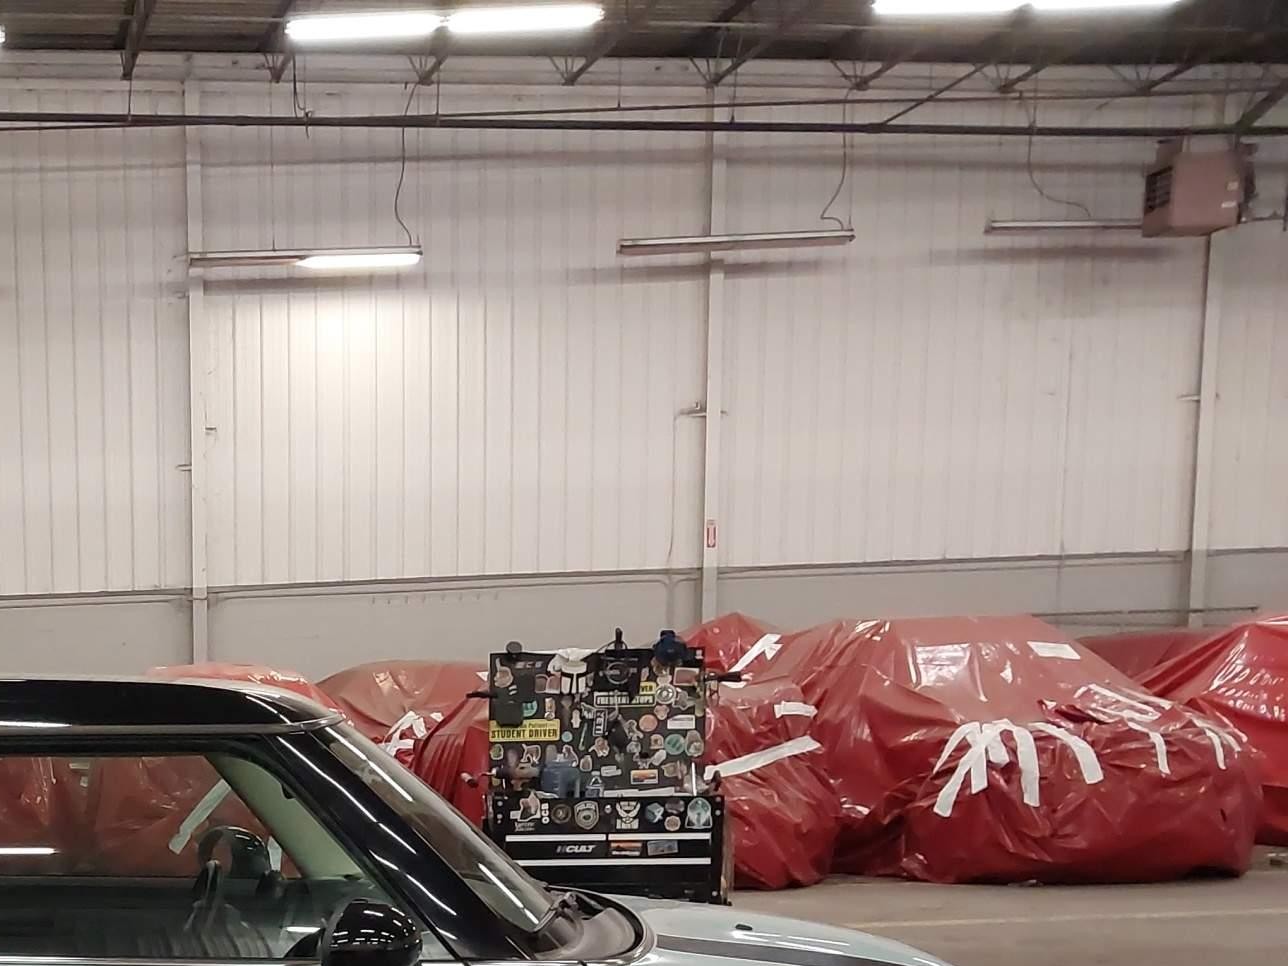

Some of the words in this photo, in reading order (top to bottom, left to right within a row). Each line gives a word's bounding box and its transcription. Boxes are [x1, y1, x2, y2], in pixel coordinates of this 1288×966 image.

[596, 710, 604, 734] YETI
[491, 729, 526, 738] STUDENT
[528, 728, 557, 738] DRIVER
